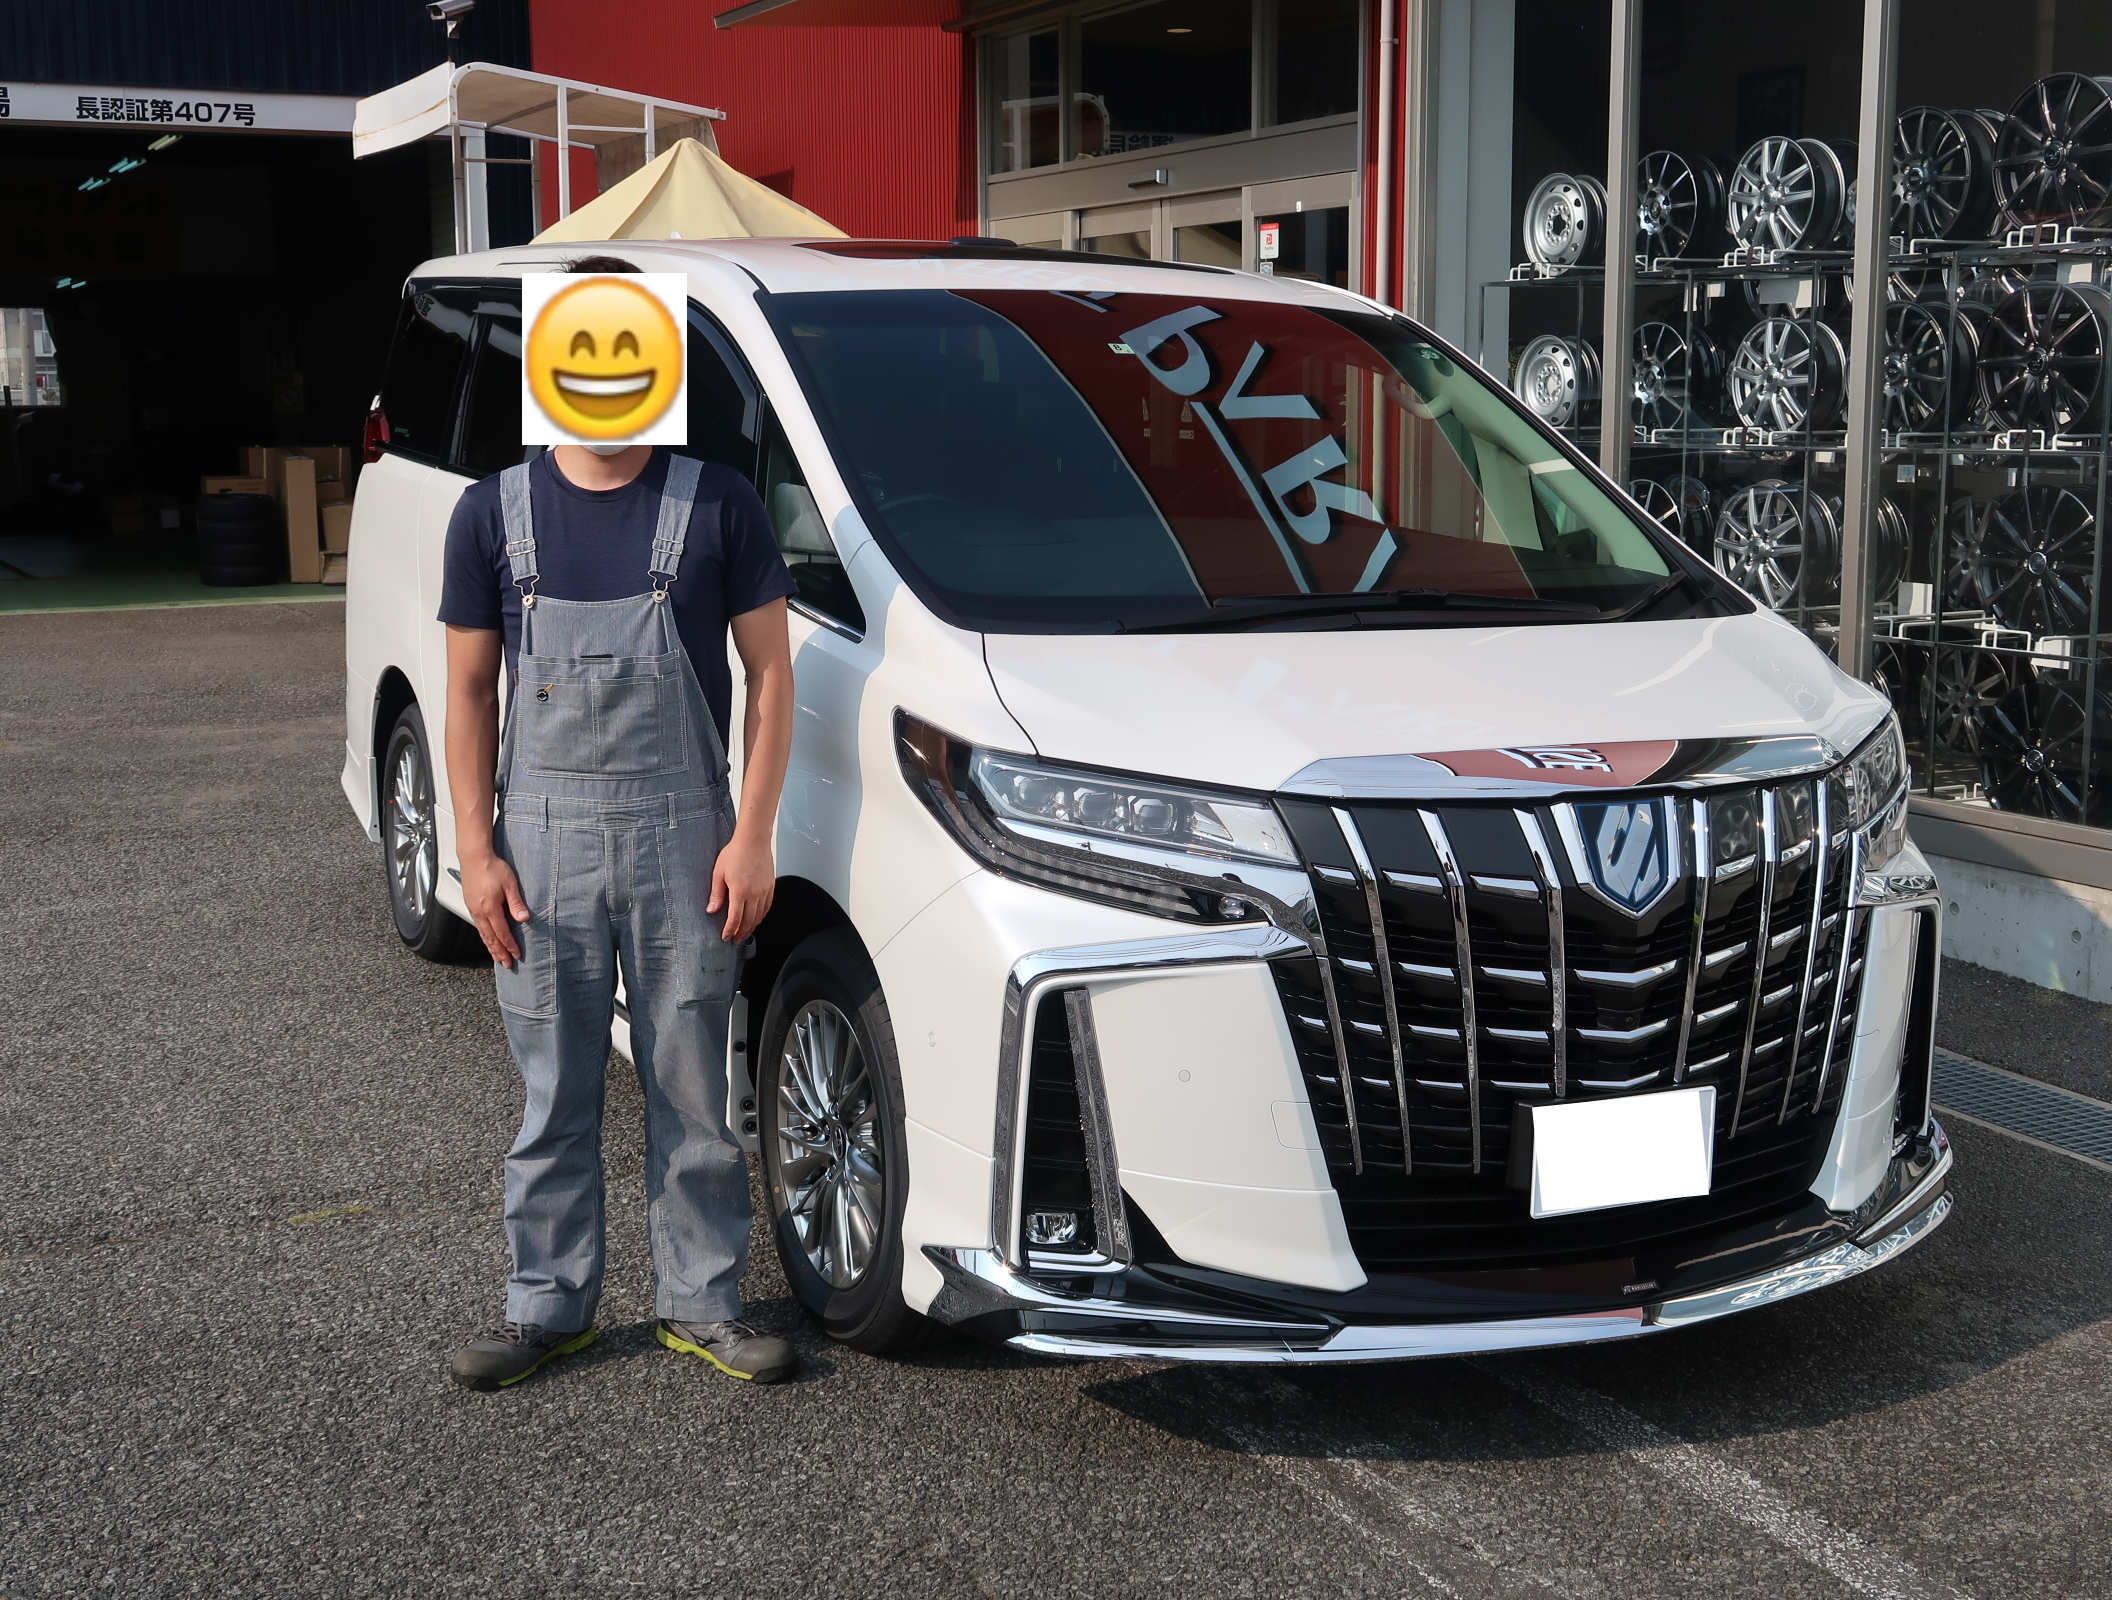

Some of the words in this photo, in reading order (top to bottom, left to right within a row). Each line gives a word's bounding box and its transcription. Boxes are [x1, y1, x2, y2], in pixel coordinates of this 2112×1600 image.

[76, 96, 256, 127] 長認証第407号
